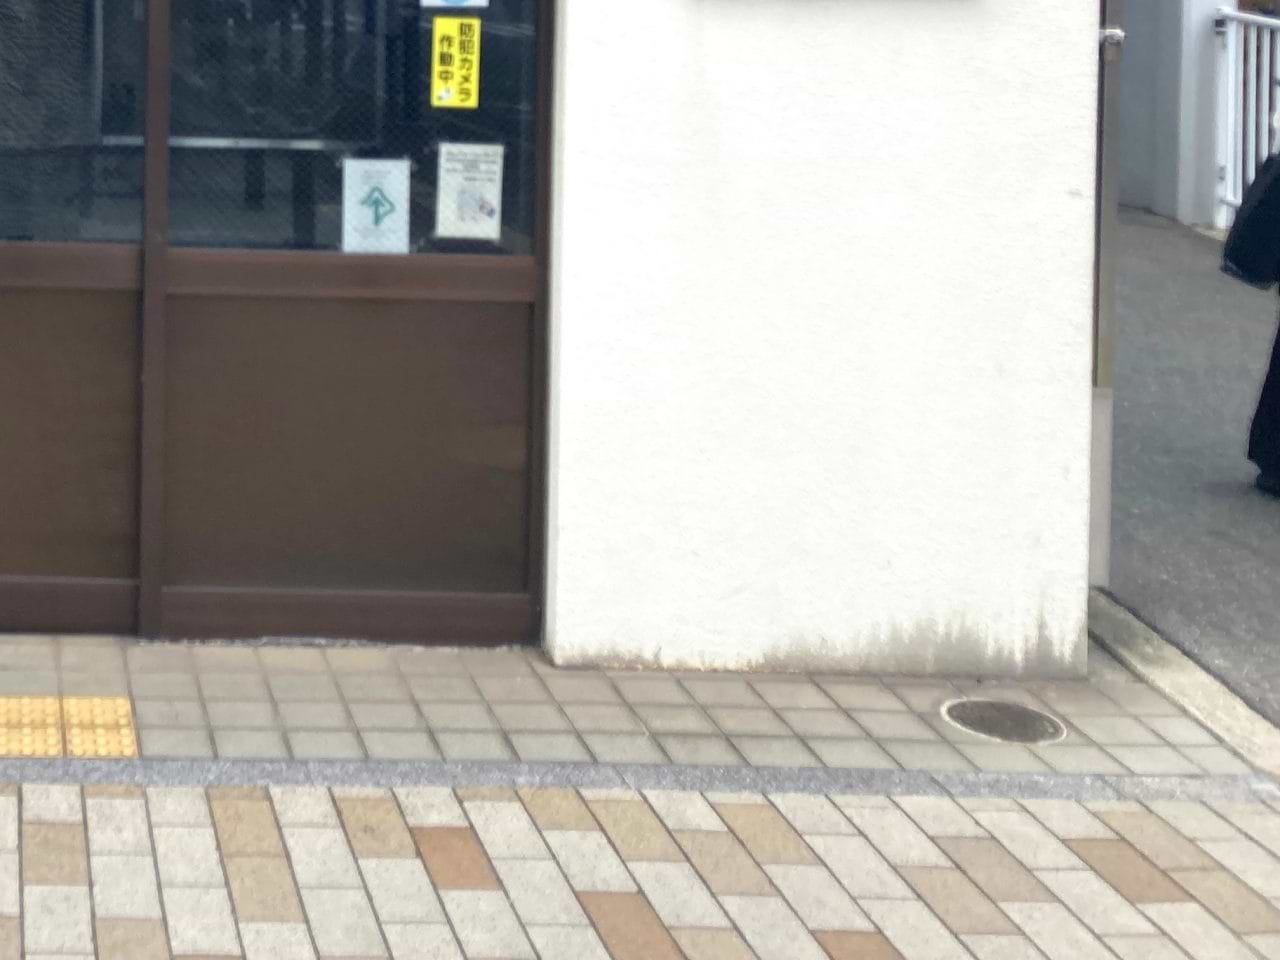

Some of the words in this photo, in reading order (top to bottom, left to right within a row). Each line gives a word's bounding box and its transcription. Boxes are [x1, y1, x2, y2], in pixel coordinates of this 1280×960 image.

[437, 34, 456, 85] 作動中
[458, 22, 476, 103] 防犯カメラ
